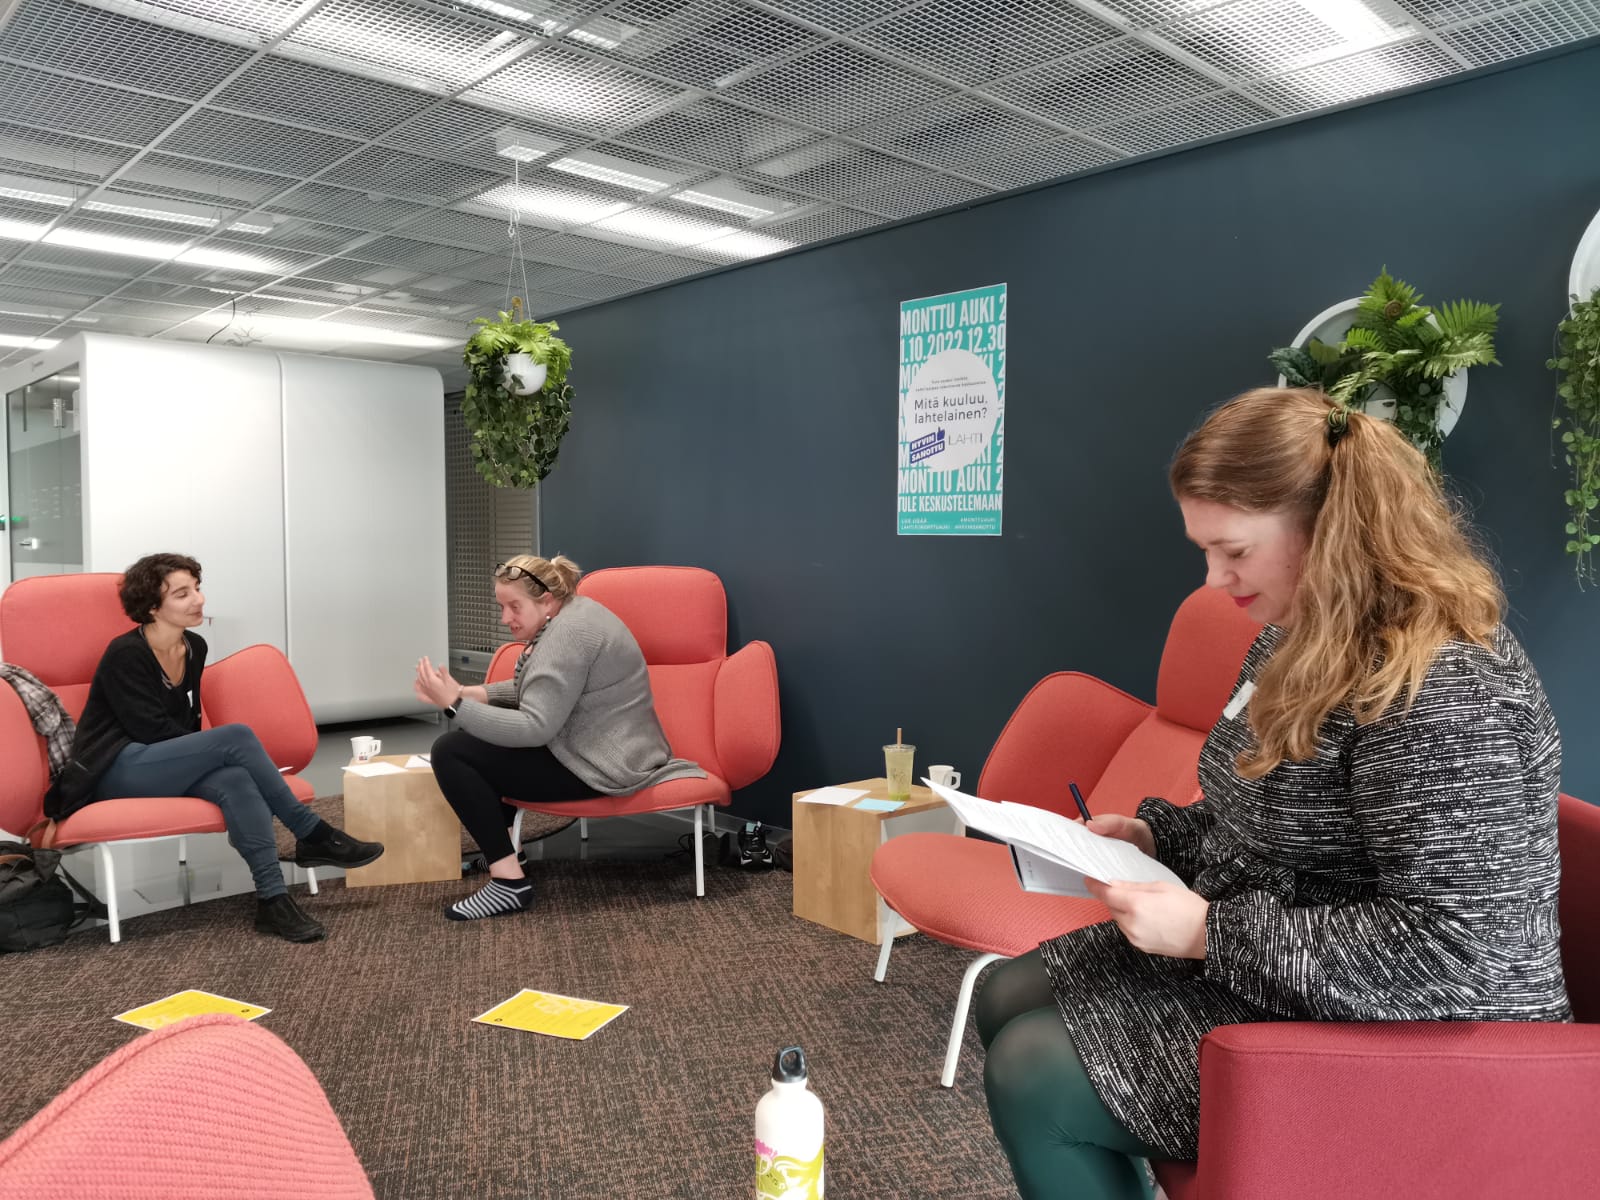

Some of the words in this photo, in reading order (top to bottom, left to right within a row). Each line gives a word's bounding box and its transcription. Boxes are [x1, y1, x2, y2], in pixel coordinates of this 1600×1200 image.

[901, 302, 955, 337] MONTTU
[959, 295, 995, 327] AUKI
[967, 323, 1006, 354] 12.30
[914, 396, 939, 410] Mitä
[914, 407, 988, 424] lahtelainen?
[911, 434, 935, 450] HYVIN
[948, 432, 983, 446] LAHTI
[911, 442, 943, 462] SANOTTU
[956, 464, 991, 492] AUKI
[899, 495, 917, 513] TULE
[919, 494, 1002, 512] KESKUSTELEMAAN
